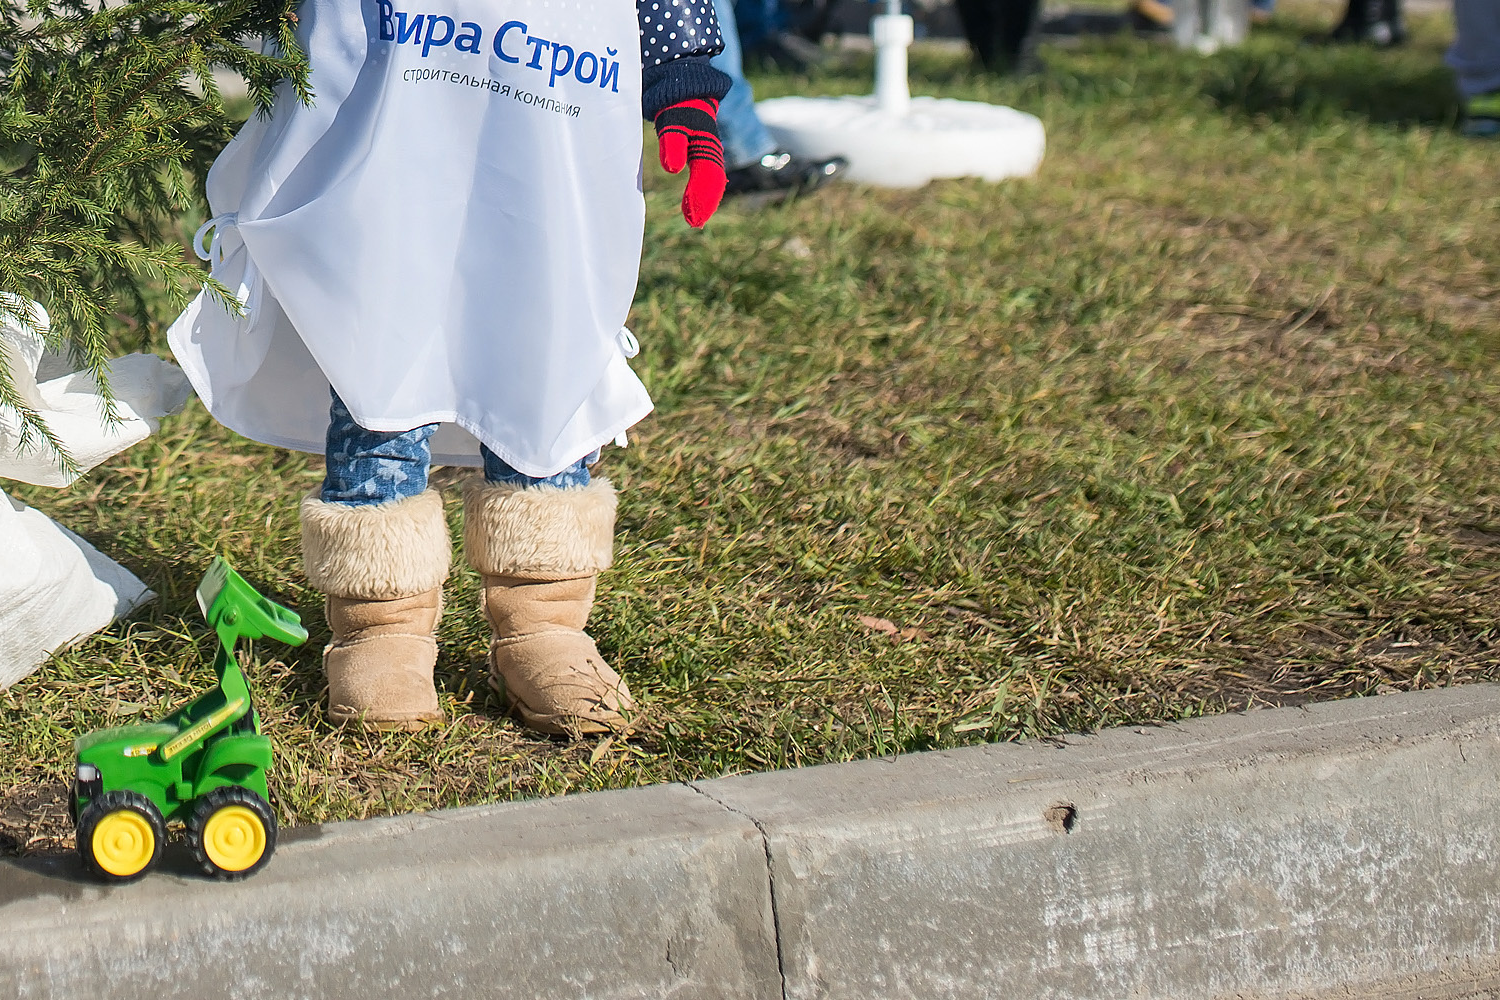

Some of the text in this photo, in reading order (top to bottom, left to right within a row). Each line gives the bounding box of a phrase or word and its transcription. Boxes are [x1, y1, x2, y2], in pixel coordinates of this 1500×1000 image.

[493, 20, 620, 93] Строй
[403, 68, 581, 118] строительная компания
